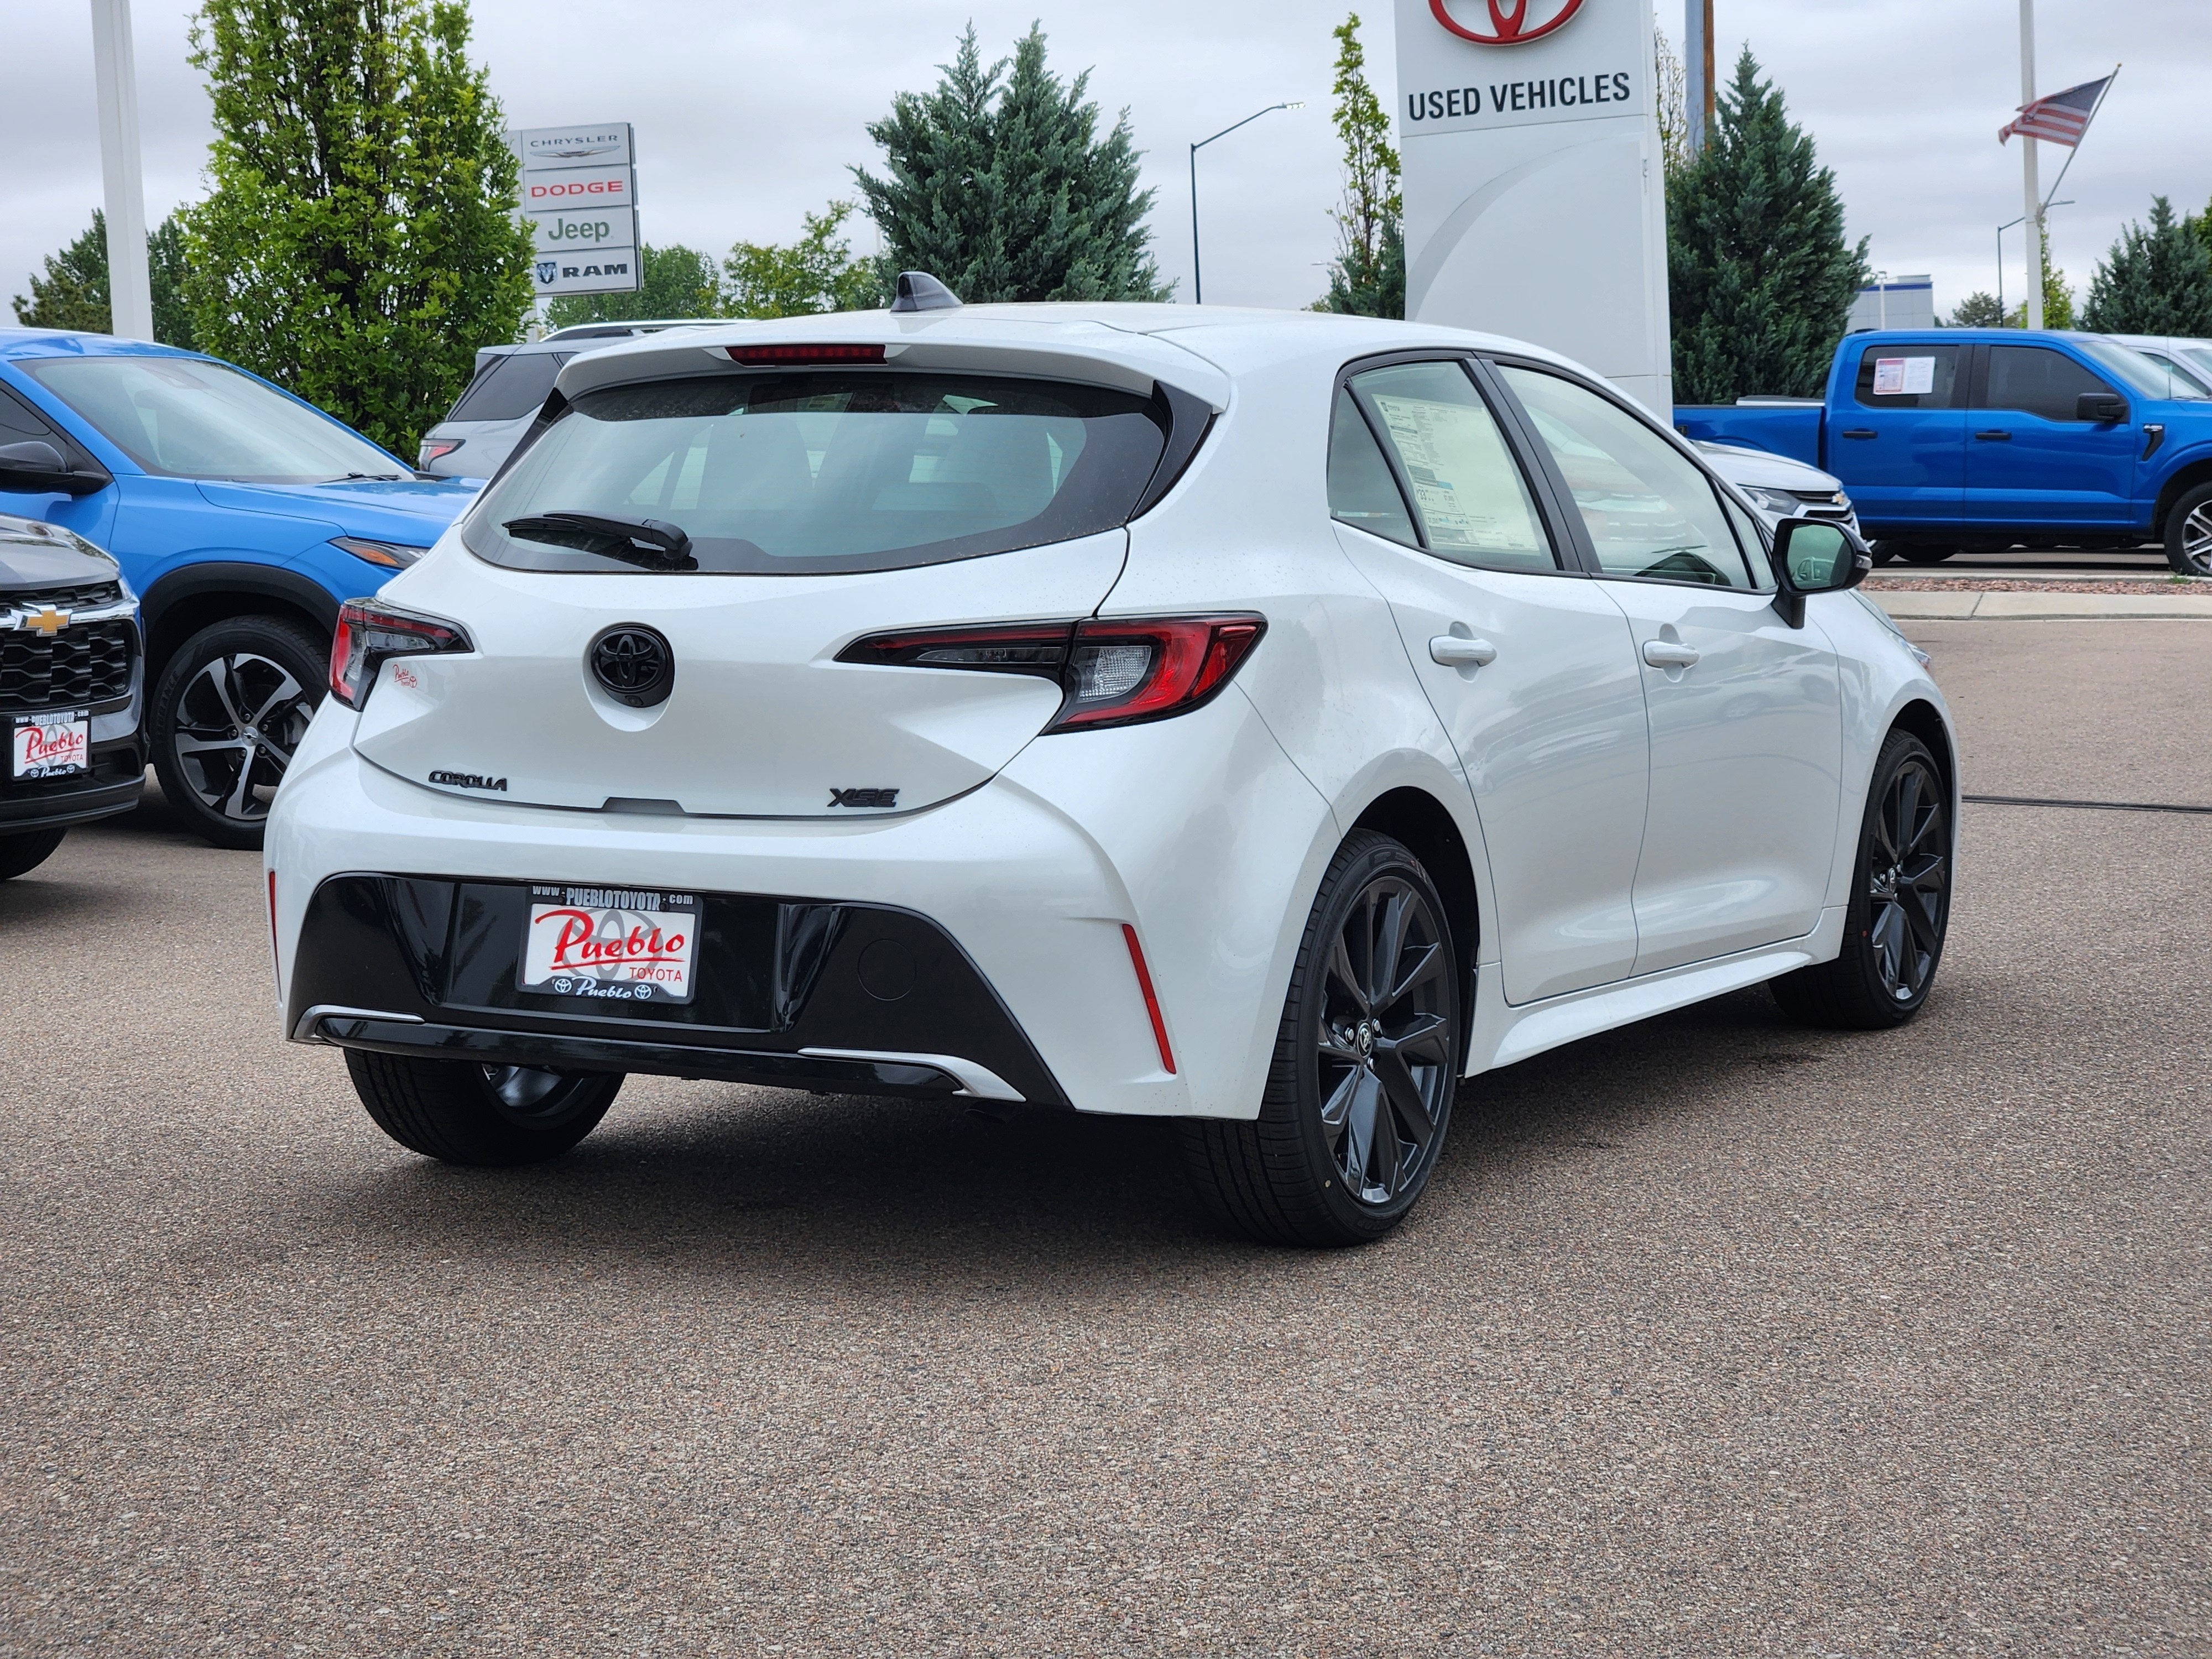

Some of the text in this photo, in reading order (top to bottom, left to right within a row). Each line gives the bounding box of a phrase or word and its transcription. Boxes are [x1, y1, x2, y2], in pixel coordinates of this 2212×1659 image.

[1408, 72, 1631, 121] USED VEHICLES
[530, 134, 618, 147] CHRYSLER
[531, 181, 623, 197] DODGE
[548, 218, 610, 243] Jeep
[562, 263, 628, 278] RAM
[15, 727, 83, 760] Pueblo
[61, 754, 84, 763] TOYOTA
[428, 770, 508, 791] COROLLA
[827, 788, 900, 807] XSE
[535, 909, 685, 963] Pueblo
[629, 967, 682, 982] TOYOTA
[571, 976, 632, 999] Pueblo
